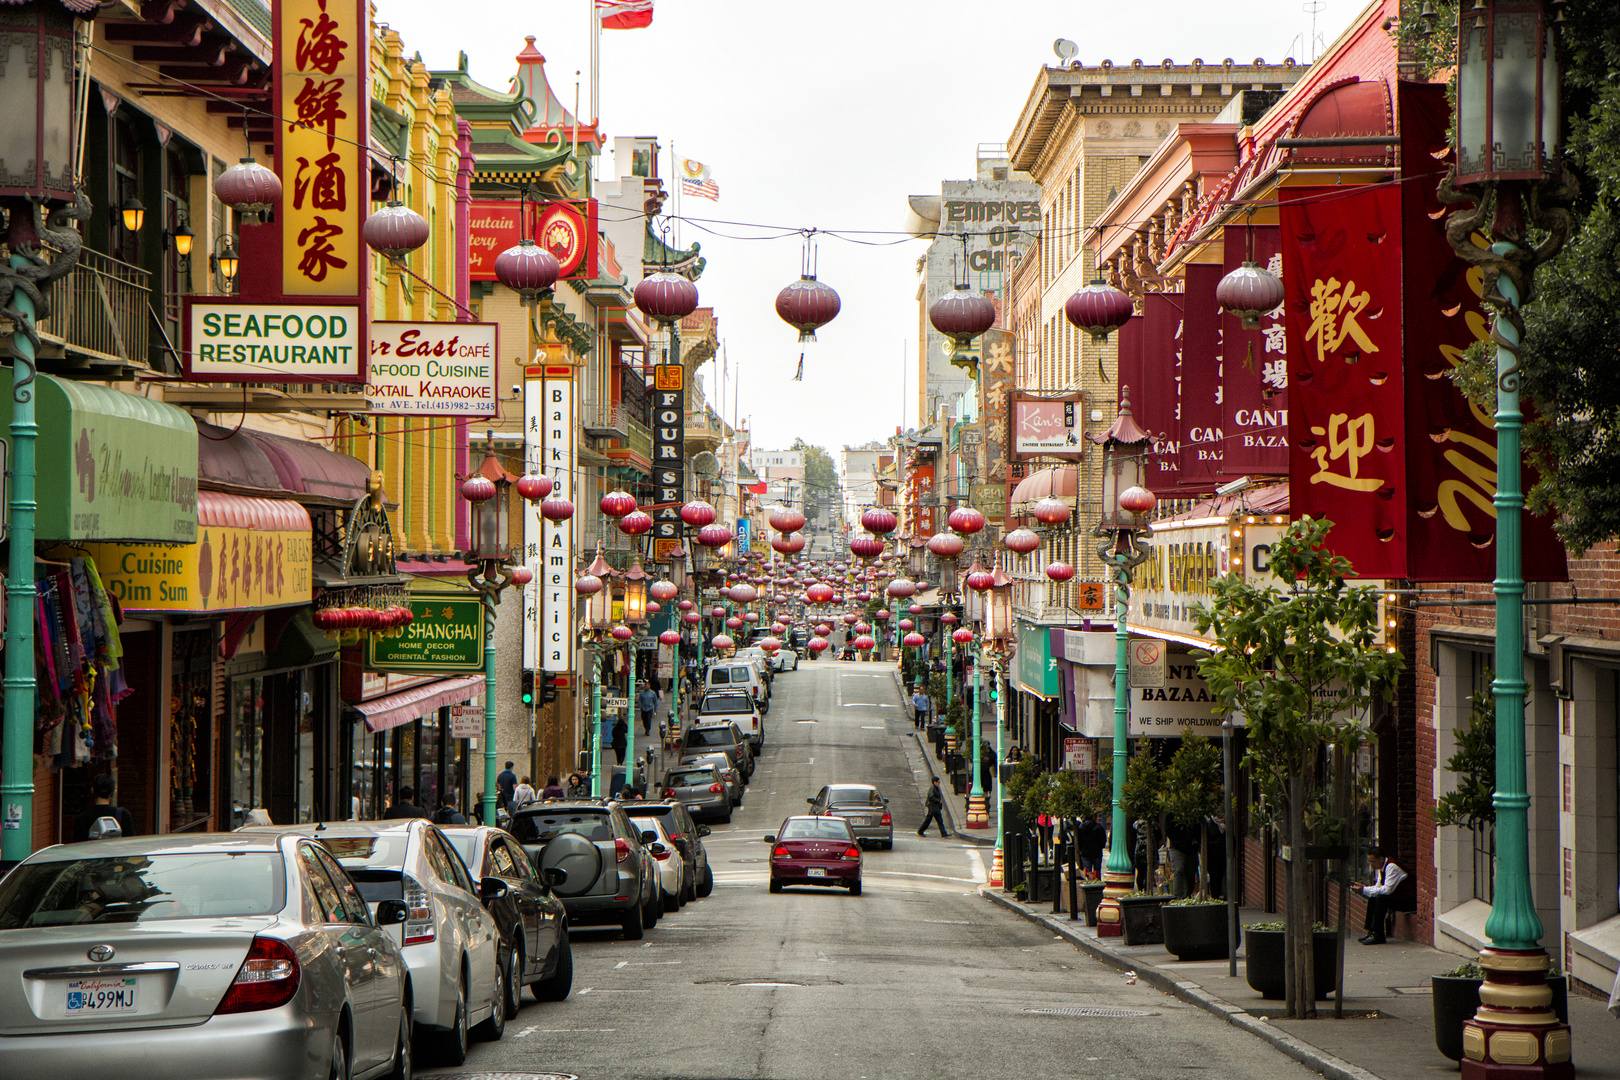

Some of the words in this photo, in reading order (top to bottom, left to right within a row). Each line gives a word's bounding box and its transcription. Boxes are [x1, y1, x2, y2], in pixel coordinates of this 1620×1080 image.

[288, 0, 348, 282] 海鮮酒家
[944, 200, 1042, 224] EMPRES
[989, 226, 1021, 247] OF
[202, 312, 347, 339] SEAFOOD
[199, 343, 353, 365] RESTAURANT
[399, 329, 459, 358] East
[459, 343, 490, 358] CAFÉ
[371, 364, 420, 378] AFOOD
[365, 383, 413, 398] CKTAIL
[1305, 276, 1385, 493] 歡迎
[552, 389, 563, 461] Bank
[660, 393, 678, 458] FOUR
[1021, 404, 1062, 433] Kan's
[1235, 409, 1289, 426] CANT
[1243, 435, 1290, 447] BAZA
[660, 472, 678, 536] SEAS
[738, 526, 746, 556] citiban
[121, 553, 183, 575] Cuisine
[110, 579, 151, 602] Dim
[159, 580, 188, 602] Sum
[550, 533, 564, 661] America
[408, 622, 477, 640] SHANGHAI
[452, 706, 462, 716] NO
[463, 708, 482, 716] PARKING
[1139, 717, 1151, 725] WE
[1155, 717, 1174, 726] SHIP
[80, 980, 125, 992] California
